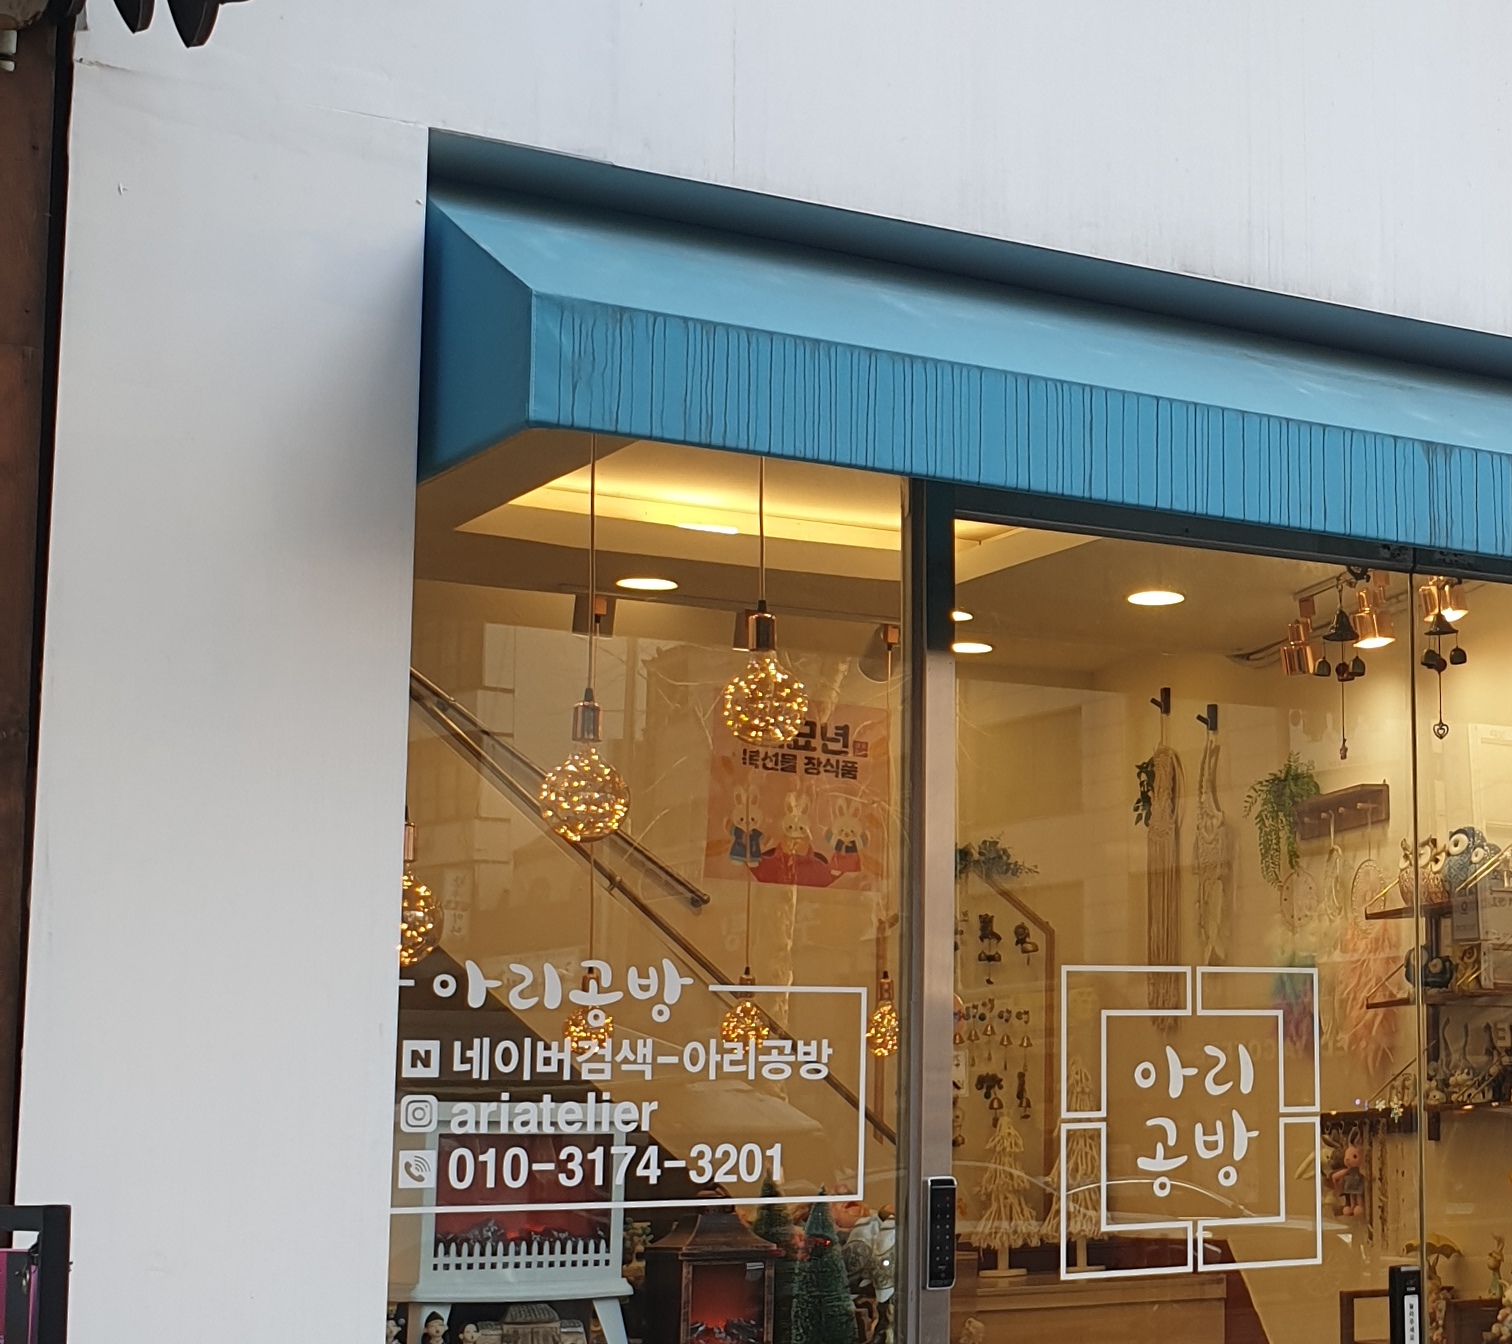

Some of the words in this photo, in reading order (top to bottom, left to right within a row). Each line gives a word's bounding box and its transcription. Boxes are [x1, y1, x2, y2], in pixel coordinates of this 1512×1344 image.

[771, 720, 850, 756] 묘년
[804, 756, 858, 780] 장식품
[433, 958, 693, 1027] 아리공방
[452, 1037, 833, 1081] 네이버검색-아리공방
[1134, 1044, 1254, 1098] 아리
[450, 1092, 657, 1135] ariatelier
[448, 1142, 782, 1192] 010-3174-3201
[1137, 1109, 1259, 1197] 공방
